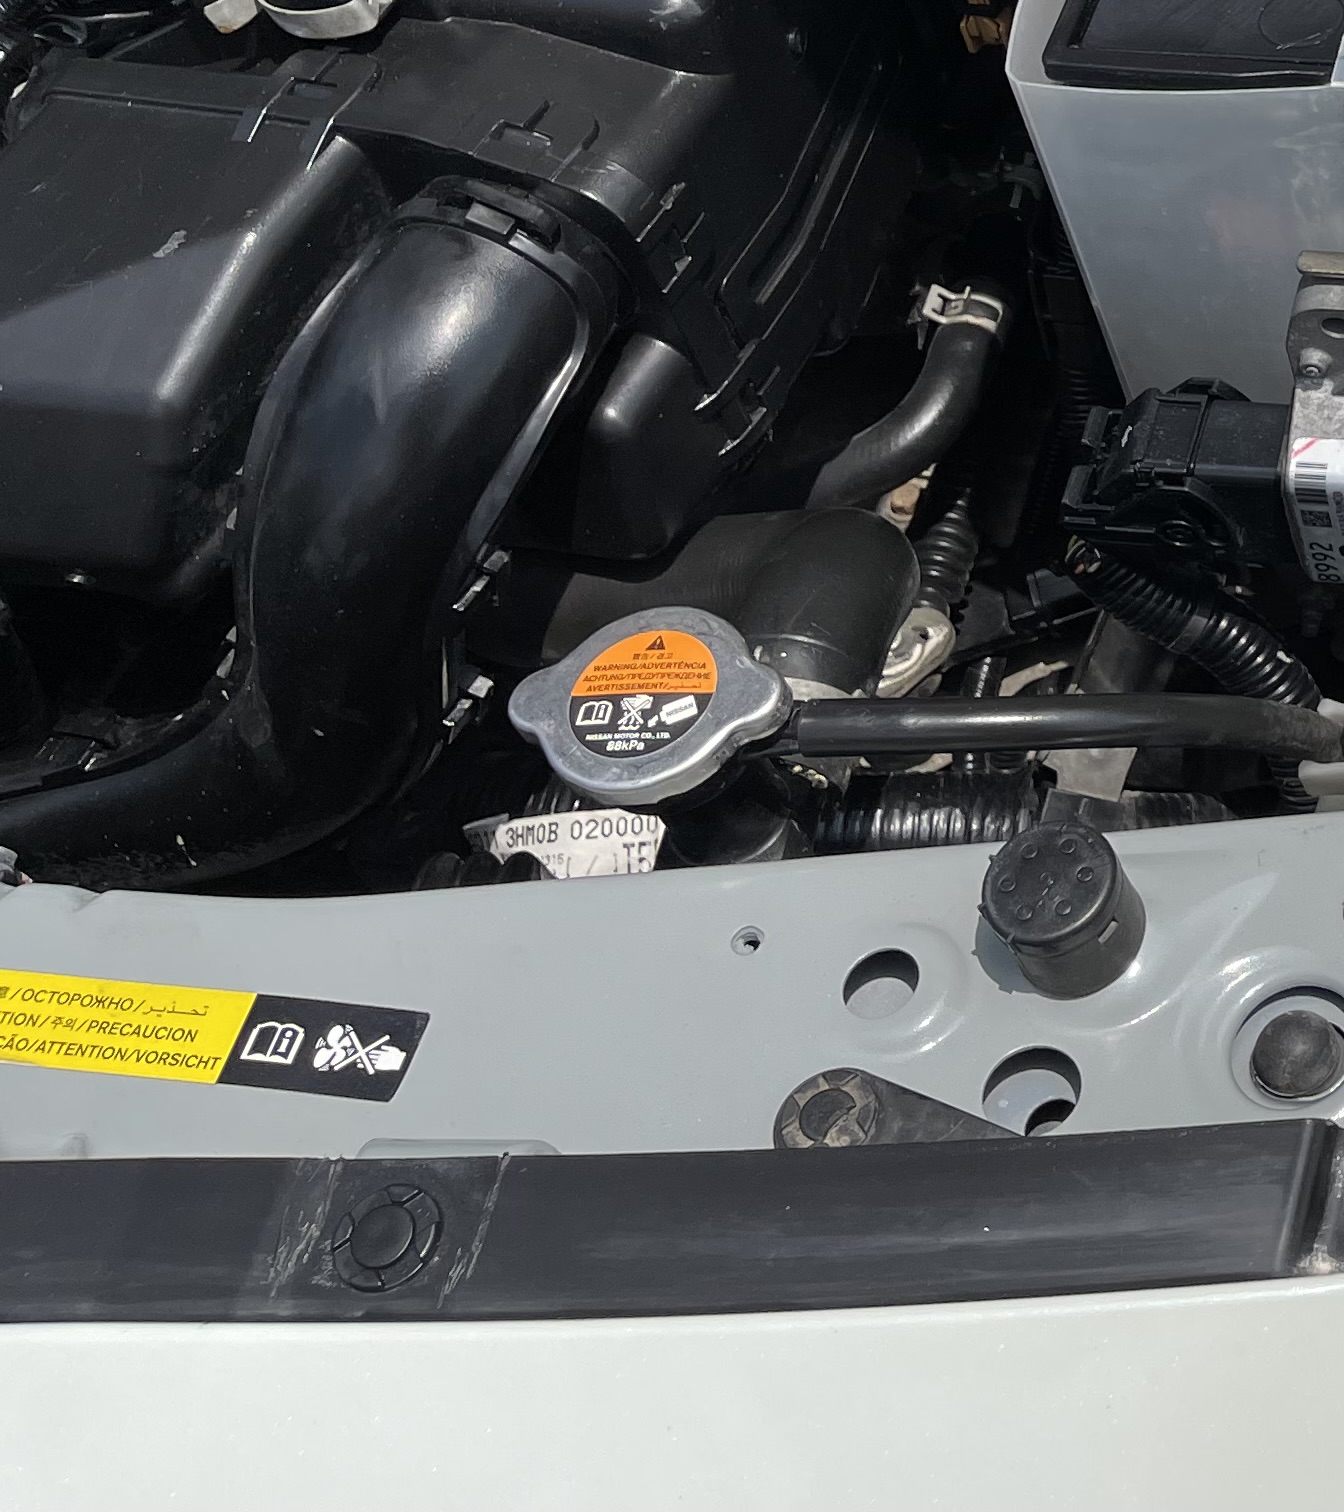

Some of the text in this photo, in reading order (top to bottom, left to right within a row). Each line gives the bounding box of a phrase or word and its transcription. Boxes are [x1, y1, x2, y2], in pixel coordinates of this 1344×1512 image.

[1309, 542, 1342, 582] 8992
[606, 740, 645, 752] 88kPa
[614, 732, 640, 740] MOTOR
[506, 822, 559, 848] 3HM0B
[570, 815, 659, 840] 020000
